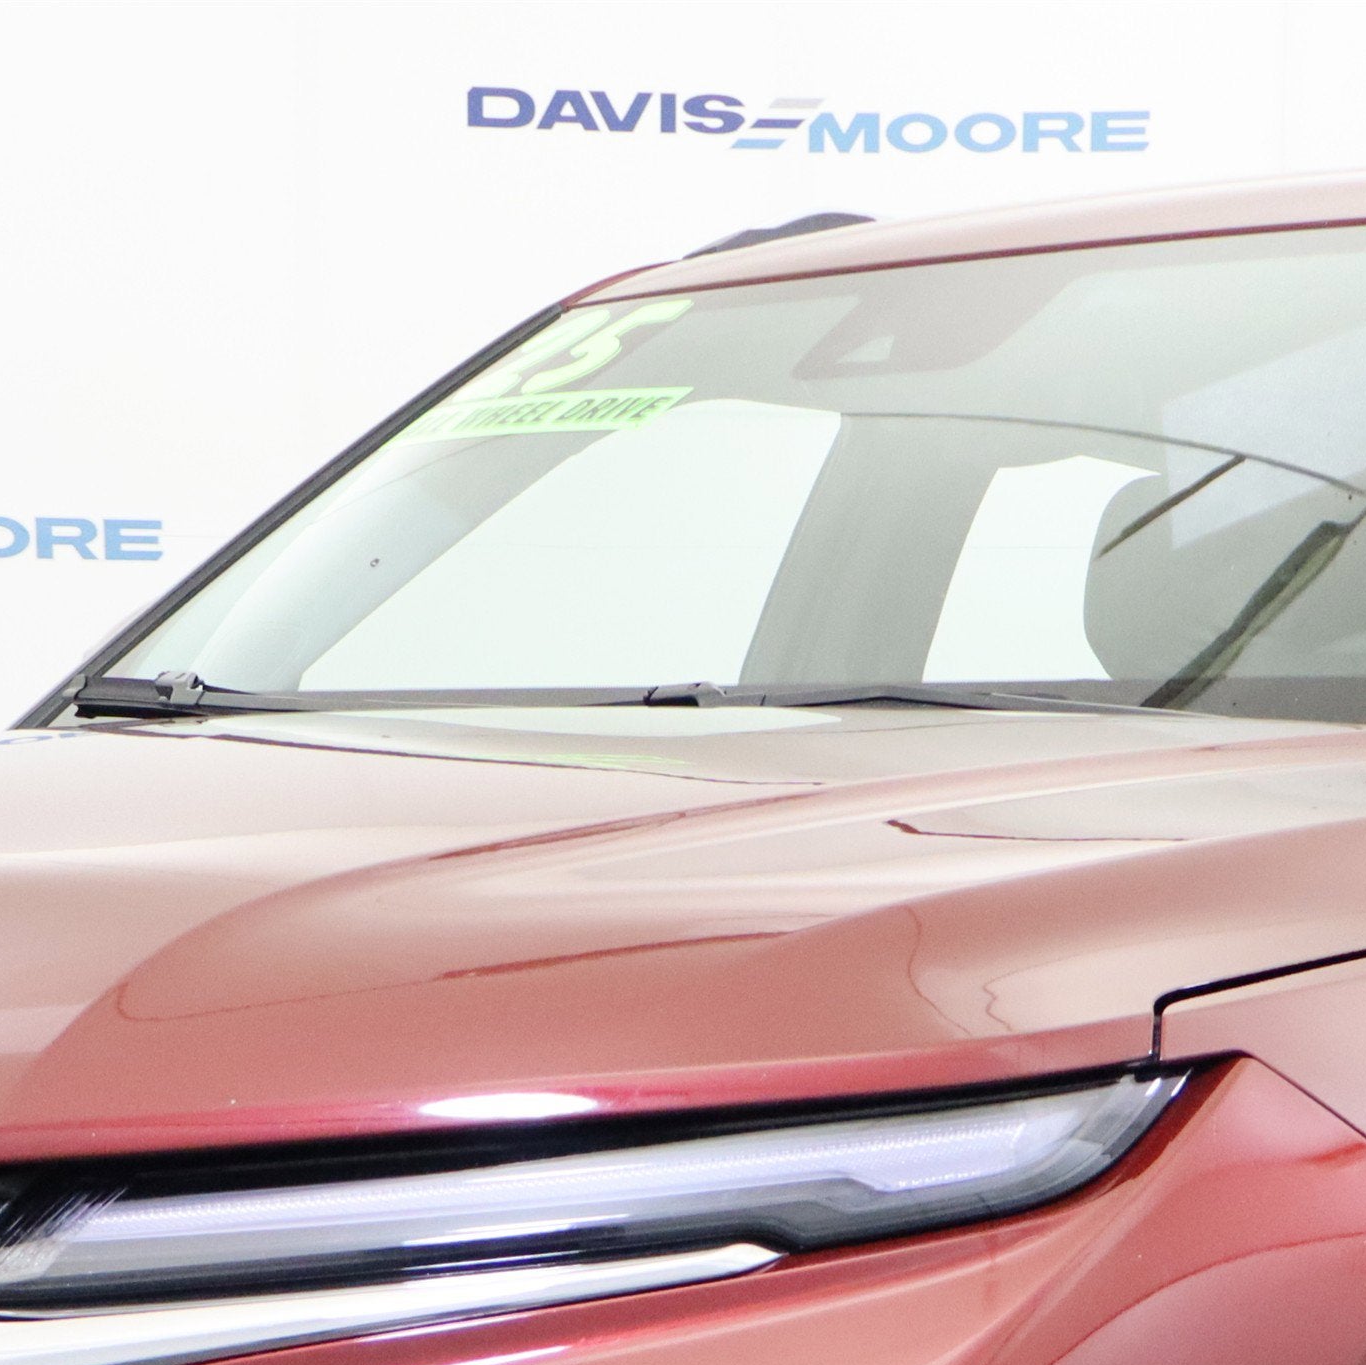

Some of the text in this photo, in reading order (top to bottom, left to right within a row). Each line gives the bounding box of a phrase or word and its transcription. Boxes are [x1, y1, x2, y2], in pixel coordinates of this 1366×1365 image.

[466, 86, 1150, 153] DAVIS MOORE
[555, 396, 673, 421] DRIVE
